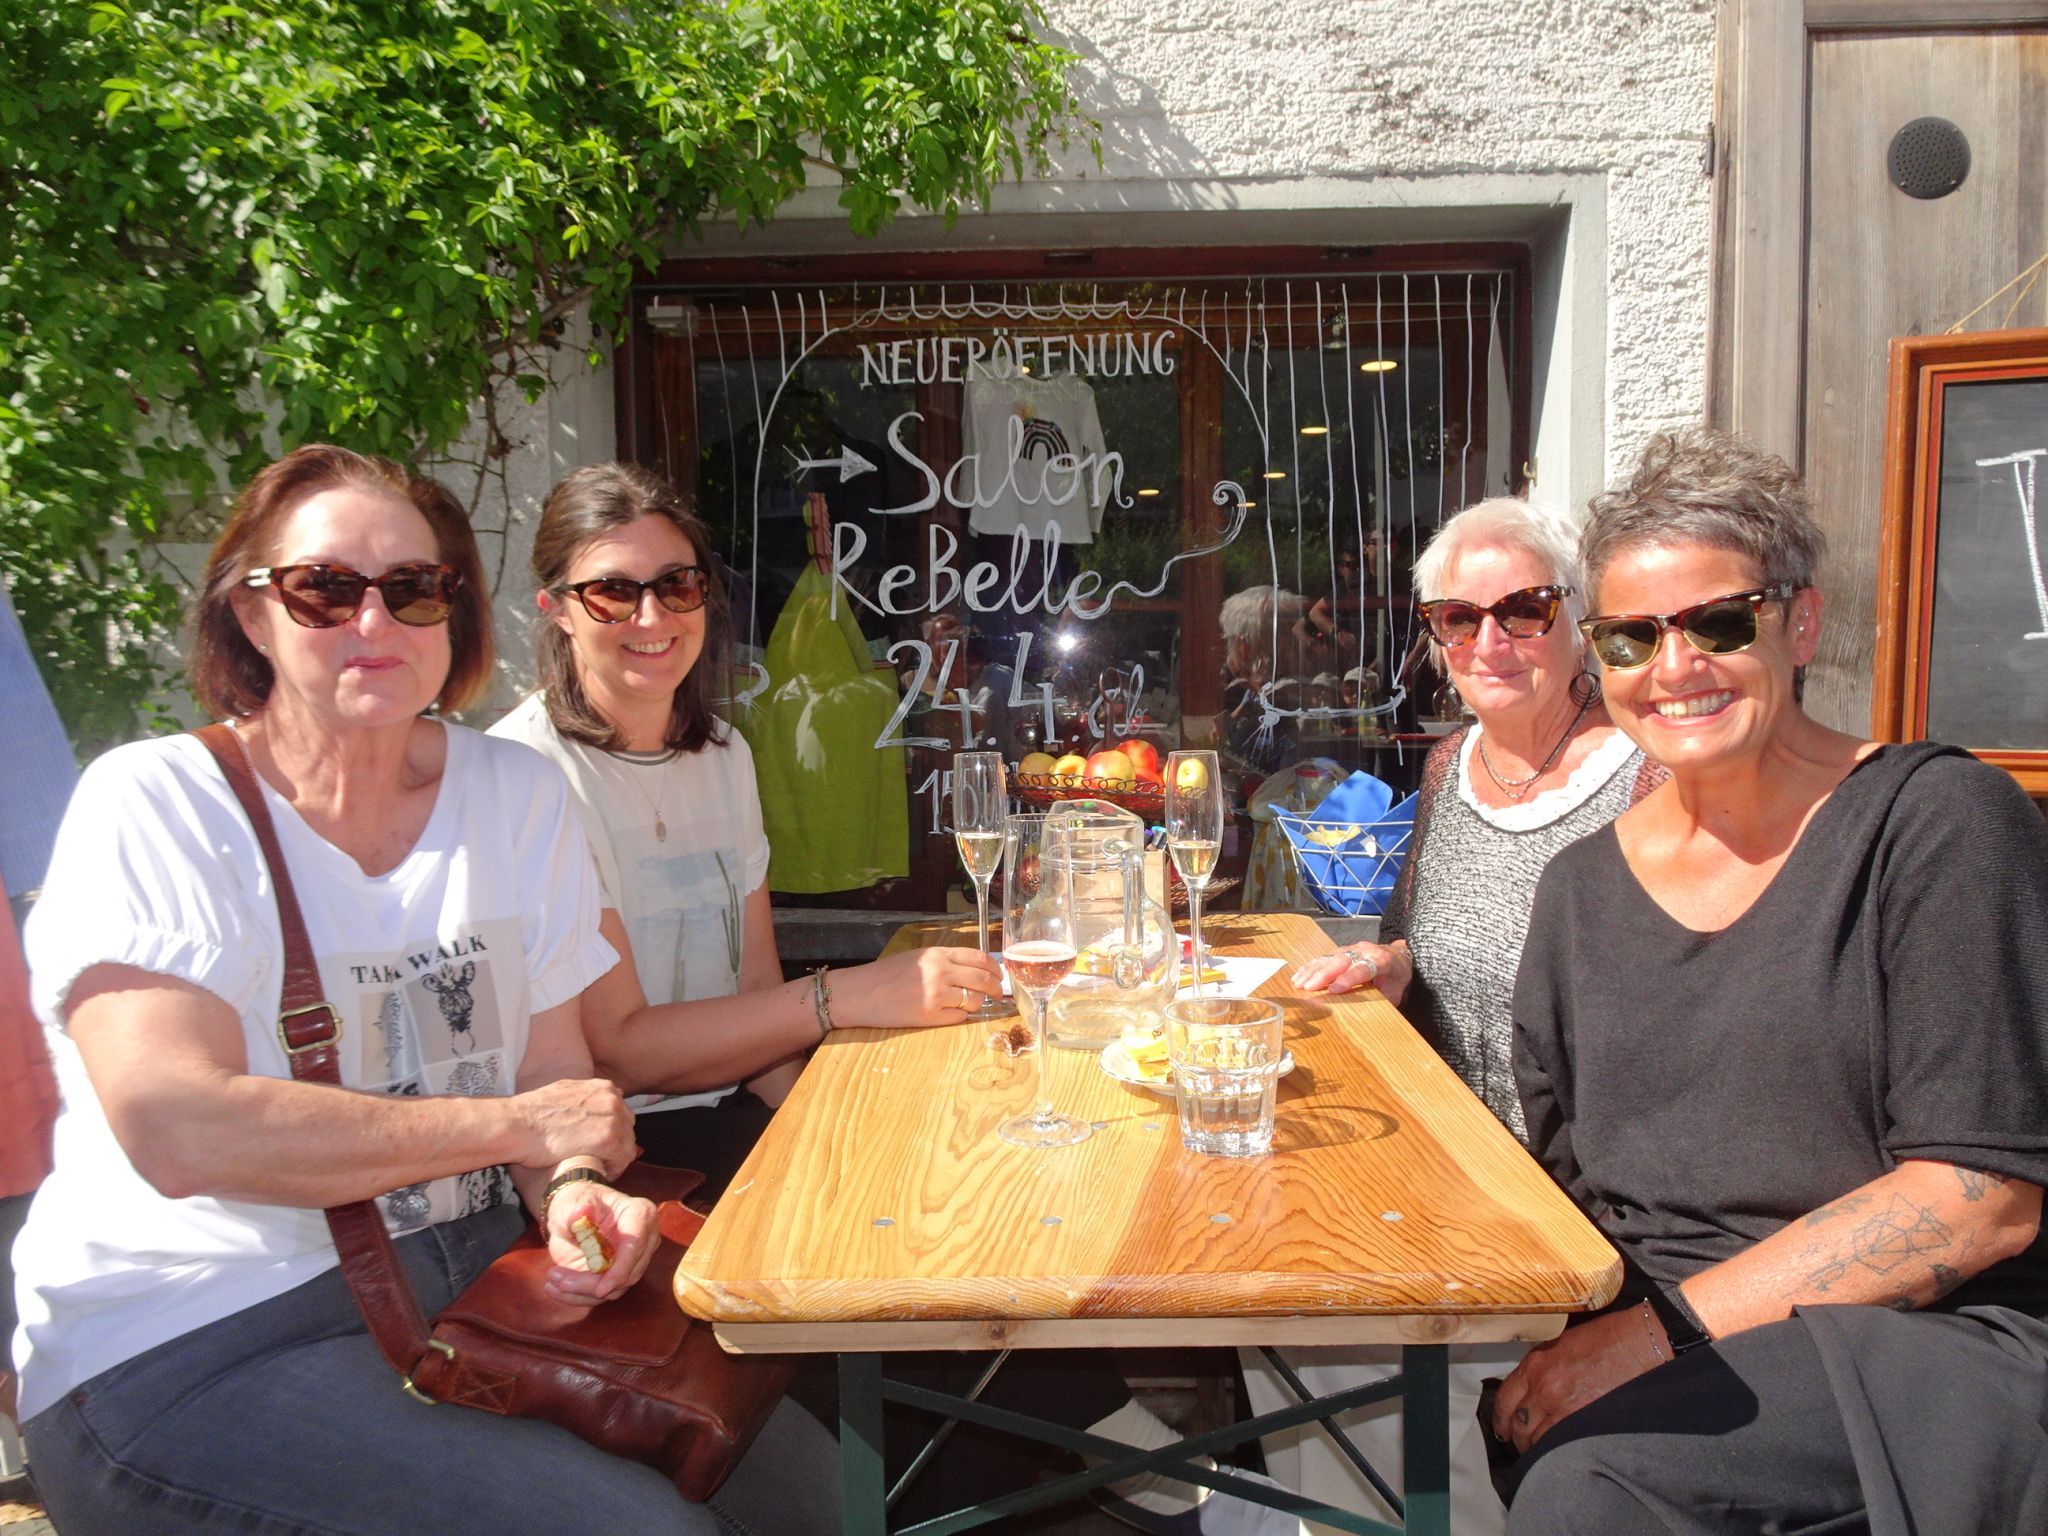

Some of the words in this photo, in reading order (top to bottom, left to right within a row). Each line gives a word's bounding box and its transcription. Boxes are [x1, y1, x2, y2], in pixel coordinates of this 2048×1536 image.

[857, 328, 1176, 389] NEUERÖFFNUNG
[868, 411, 1134, 515] Salon
[407, 933, 488, 971] WALK
